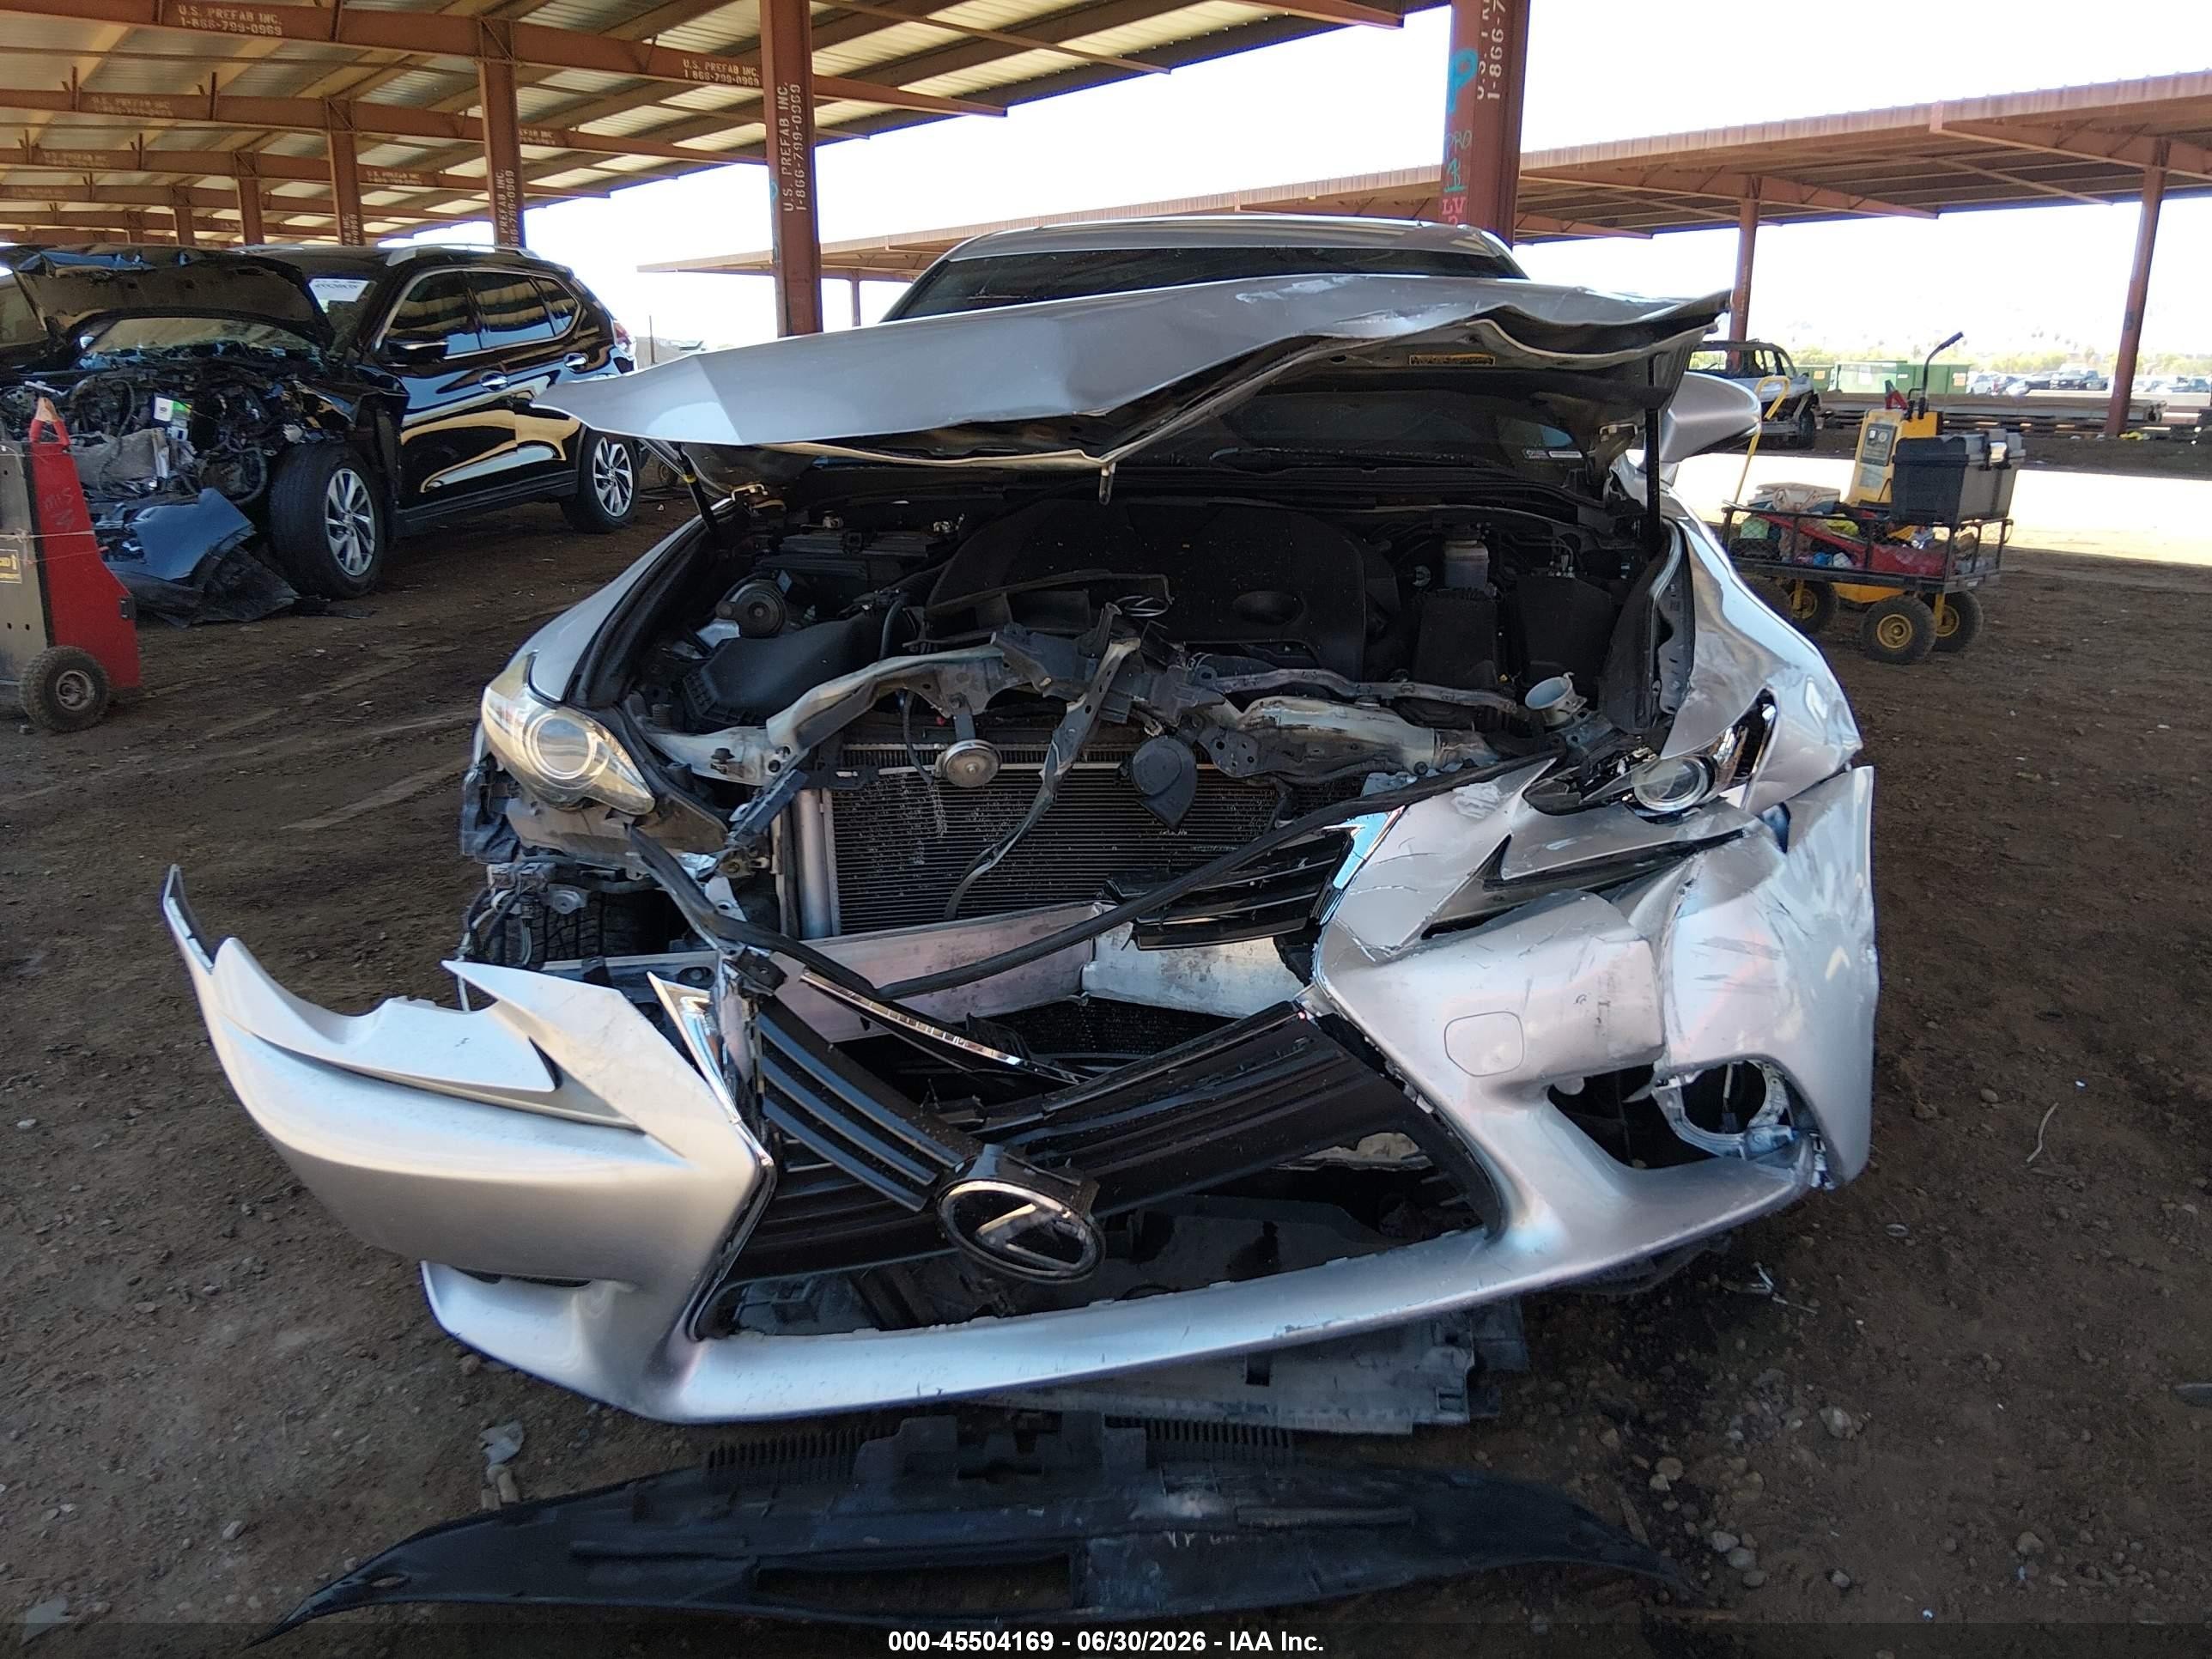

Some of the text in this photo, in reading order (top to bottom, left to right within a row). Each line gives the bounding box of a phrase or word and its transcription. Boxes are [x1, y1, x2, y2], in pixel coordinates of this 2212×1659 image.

[206, 7, 254, 21] PREFAB
[704, 61, 739, 75] PREFAB
[777, 82, 794, 212] U.S. PREFAB INC.
[789, 83, 807, 211] 1-866-799-0969
